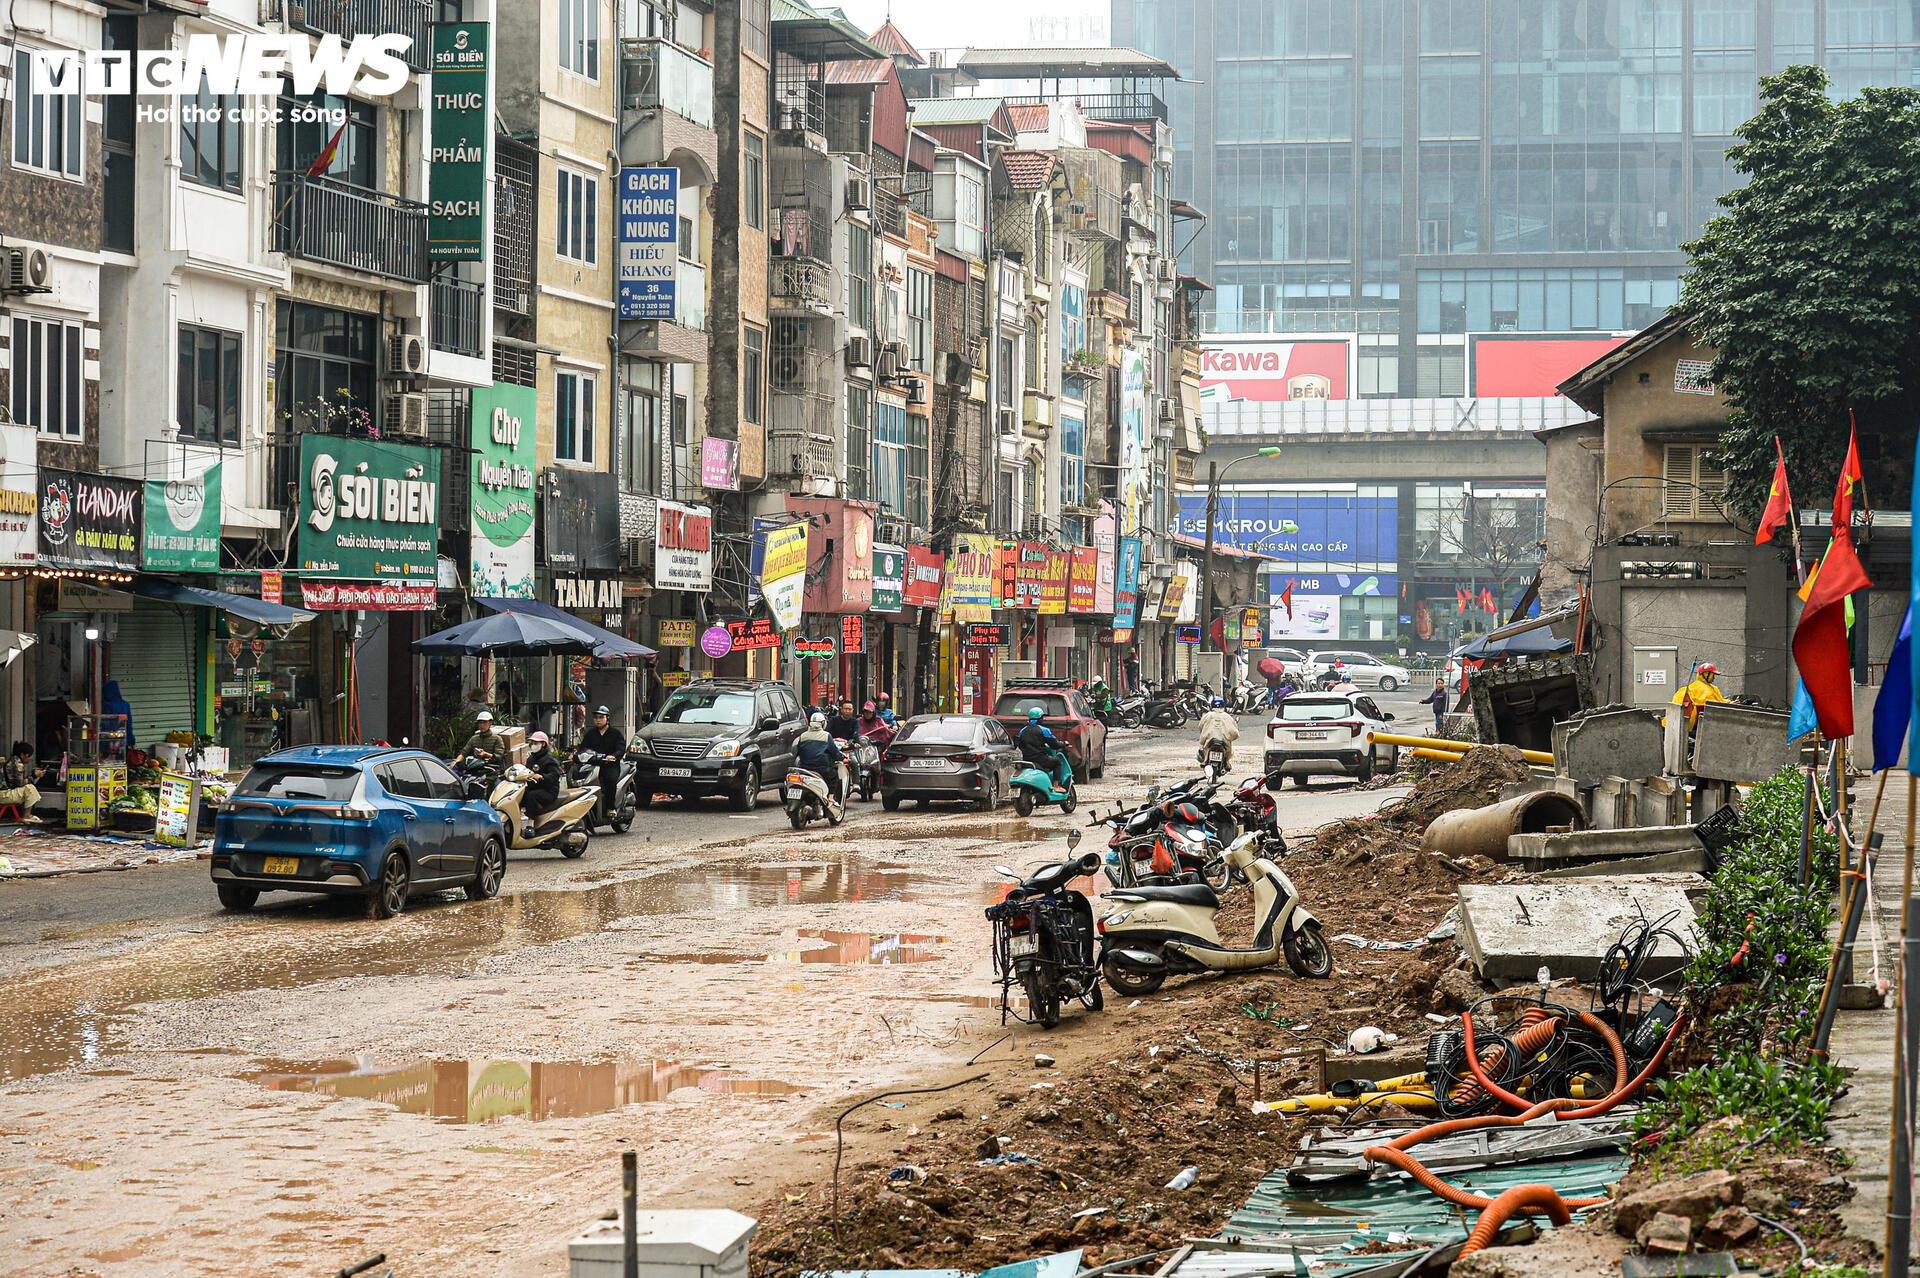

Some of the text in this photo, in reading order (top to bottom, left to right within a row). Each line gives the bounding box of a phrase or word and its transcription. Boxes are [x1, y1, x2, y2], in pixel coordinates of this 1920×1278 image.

[436, 48, 484, 63] SÓI BIỂN
[434, 91, 482, 113] THỰC
[432, 137, 482, 163] PHẨM
[628, 174, 670, 194] GẠCH
[432, 200, 480, 221] SẠCH
[622, 195, 675, 215] KHÔNG
[626, 221, 670, 238] NUNG
[629, 243, 665, 260] HIẾU
[622, 265, 672, 277] KHANG
[647, 284, 659, 293] 36
[1293, 382, 1325, 399] BỀN
[491, 407, 522, 452] Chợ
[479, 458, 533, 491] Nguyễn Tuân
[165, 480, 203, 505] QUEN
[337, 461, 379, 521] SÓI
[381, 462, 436, 524] BIỂN
[75, 526, 85, 546] GÀ
[85, 528, 101, 548] RÁN
[101, 530, 118, 550] HÀN
[336, 532, 432, 555] Chuỗi cửa hàng thực phẩm sạch
[1278, 540, 1297, 551] SẢN
[1301, 543, 1323, 551] CAO
[1327, 540, 1348, 552] CẤP
[554, 570, 624, 608] TÂM AN
[1300, 579, 1320, 590] MB
[605, 614, 622, 628] HAIR
[661, 621, 692, 631] PATE
